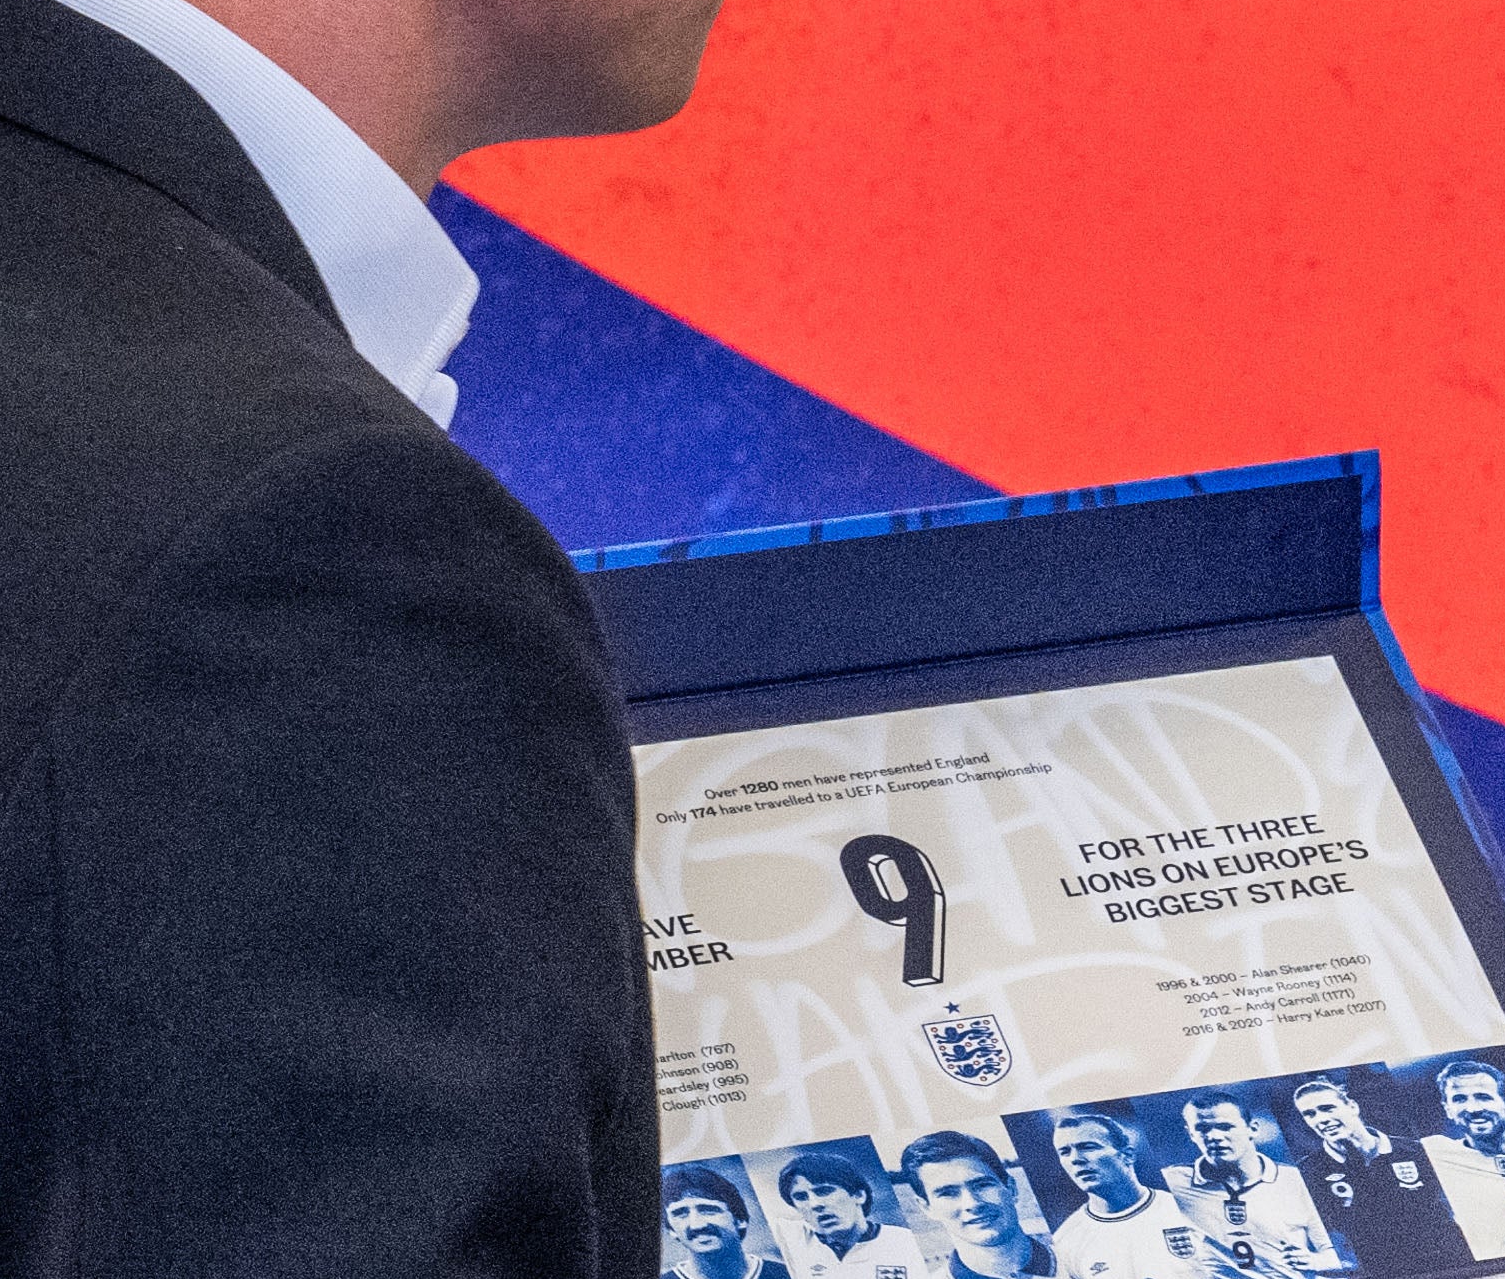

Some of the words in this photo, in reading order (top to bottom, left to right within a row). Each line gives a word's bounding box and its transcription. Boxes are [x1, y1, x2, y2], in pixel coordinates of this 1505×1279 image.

[656, 809, 687, 825] Only
[690, 805, 717, 820] 174
[719, 799, 752, 816] have
[754, 793, 814, 811] travelled
[817, 790, 832, 802] to
[835, 791, 843, 800] a
[845, 784, 885, 799] UEFA
[888, 775, 954, 793] European
[955, 762, 1052, 785] Championship
[705, 786, 737, 800] Over
[740, 780, 778, 795] 1280
[782, 778, 812, 790] men
[814, 772, 846, 786] have
[850, 760, 932, 782] represented
[935, 753, 990, 773] England
[1079, 839, 1145, 864] FOR
[1146, 828, 1214, 853] THE
[1216, 815, 1325, 844] THREE
[1060, 867, 1156, 897] LIONS
[1162, 860, 1209, 883] ON
[840, 834, 946, 987] 9
[1105, 887, 1238, 923] BIGGEST
[1247, 873, 1354, 903] STAGE
[1156, 979, 1187, 991] 1996
[1190, 978, 1199, 986] &
[1203, 973, 1237, 985] 2000
[1252, 969, 1278, 979] Alan
[1280, 962, 1327, 975] Shearer
[1330, 954, 1370, 969] (1040)
[1184, 991, 1218, 1004] 2004
[1232, 985, 1274, 998] Wayne
[1277, 979, 1321, 992] Rooney
[1323, 971, 1357, 986] (1114)
[1182, 1024, 1213, 1036] 2016
[1217, 1023, 1227, 1031] &
[1231, 1017, 1263, 1030] 2020
[1277, 1012, 1312, 1024] Harry
[1314, 1006, 1344, 1018] Kane
[1347, 1000, 1386, 1015] (1207)
[1200, 1005, 1231, 1018] 2012
[1246, 1000, 1275, 1012] Andy
[1279, 995, 1320, 1007] Carroll
[1322, 988, 1355, 1002] (1171)
[701, 1043, 735, 1058] (767)
[702, 1059, 738, 1074] (908)
[655, 1081, 709, 1096] eardsley
[713, 1074, 749, 1089] (995)
[662, 1097, 705, 1111] Clough
[708, 1090, 746, 1106] (1013)
[1233, 1240, 1256, 1270] 9
